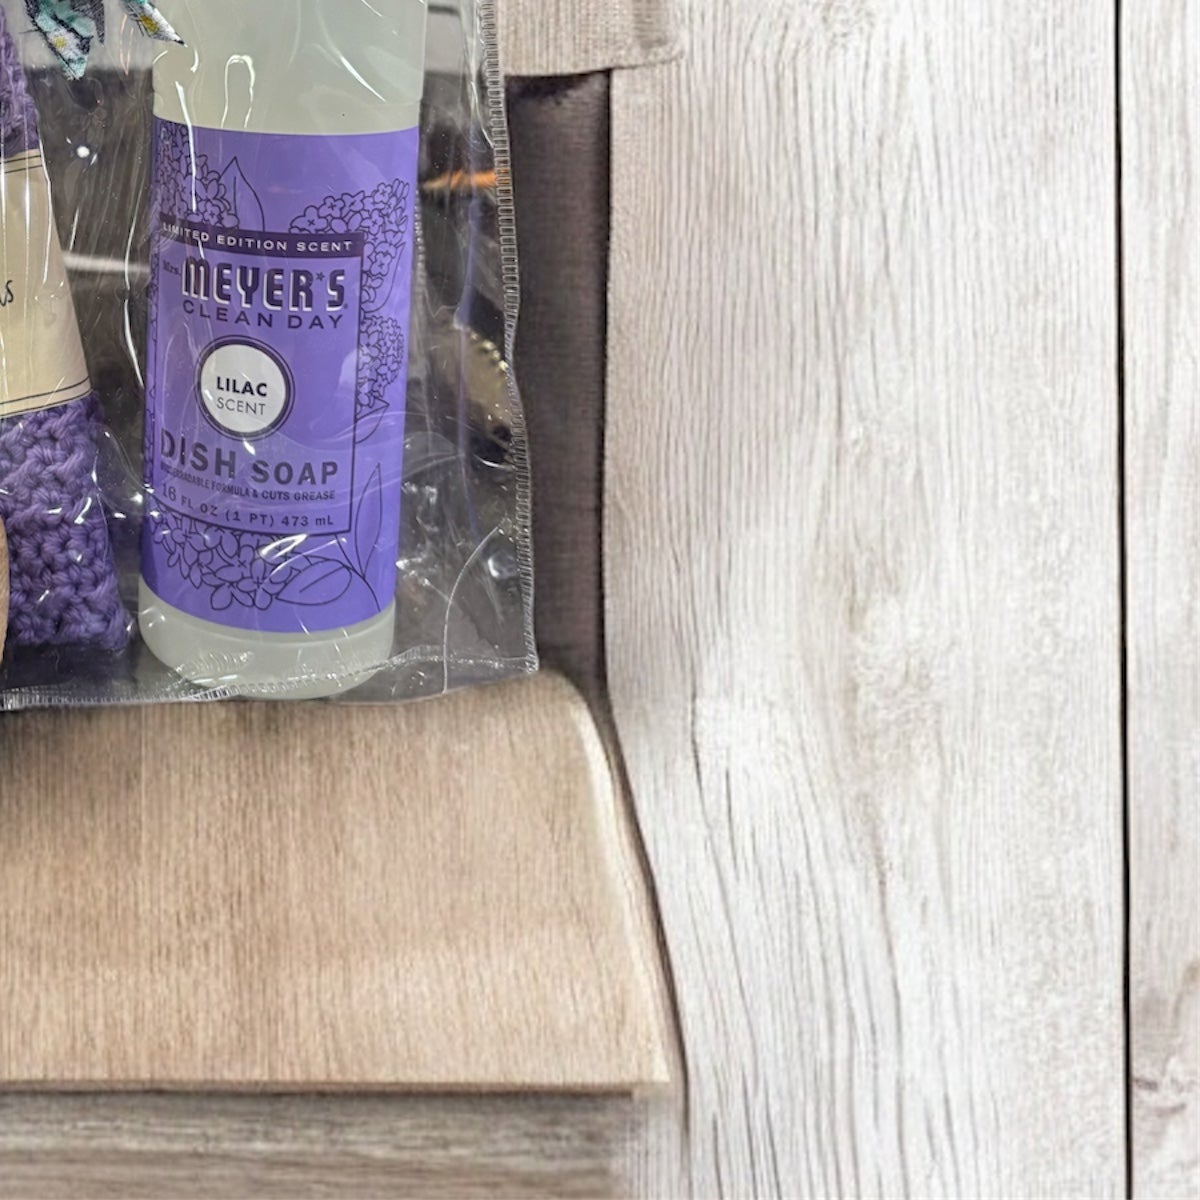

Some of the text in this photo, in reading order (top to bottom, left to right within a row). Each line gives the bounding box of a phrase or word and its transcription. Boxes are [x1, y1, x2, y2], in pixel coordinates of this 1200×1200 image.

[162, 222, 353, 252] LIMITED EDITION SCENT
[182, 300, 344, 330] CLEAN DAY
[216, 376, 268, 397] LILAC
[216, 397, 267, 416] SCENT
[160, 428, 339, 486] DISH SOAP
[162, 483, 335, 527] 16 FL OZ (1 PT) 473 mL
[211, 481, 250, 498] FORMULA
[261, 490, 290, 501] CUTS
[294, 489, 336, 502] GREASE
